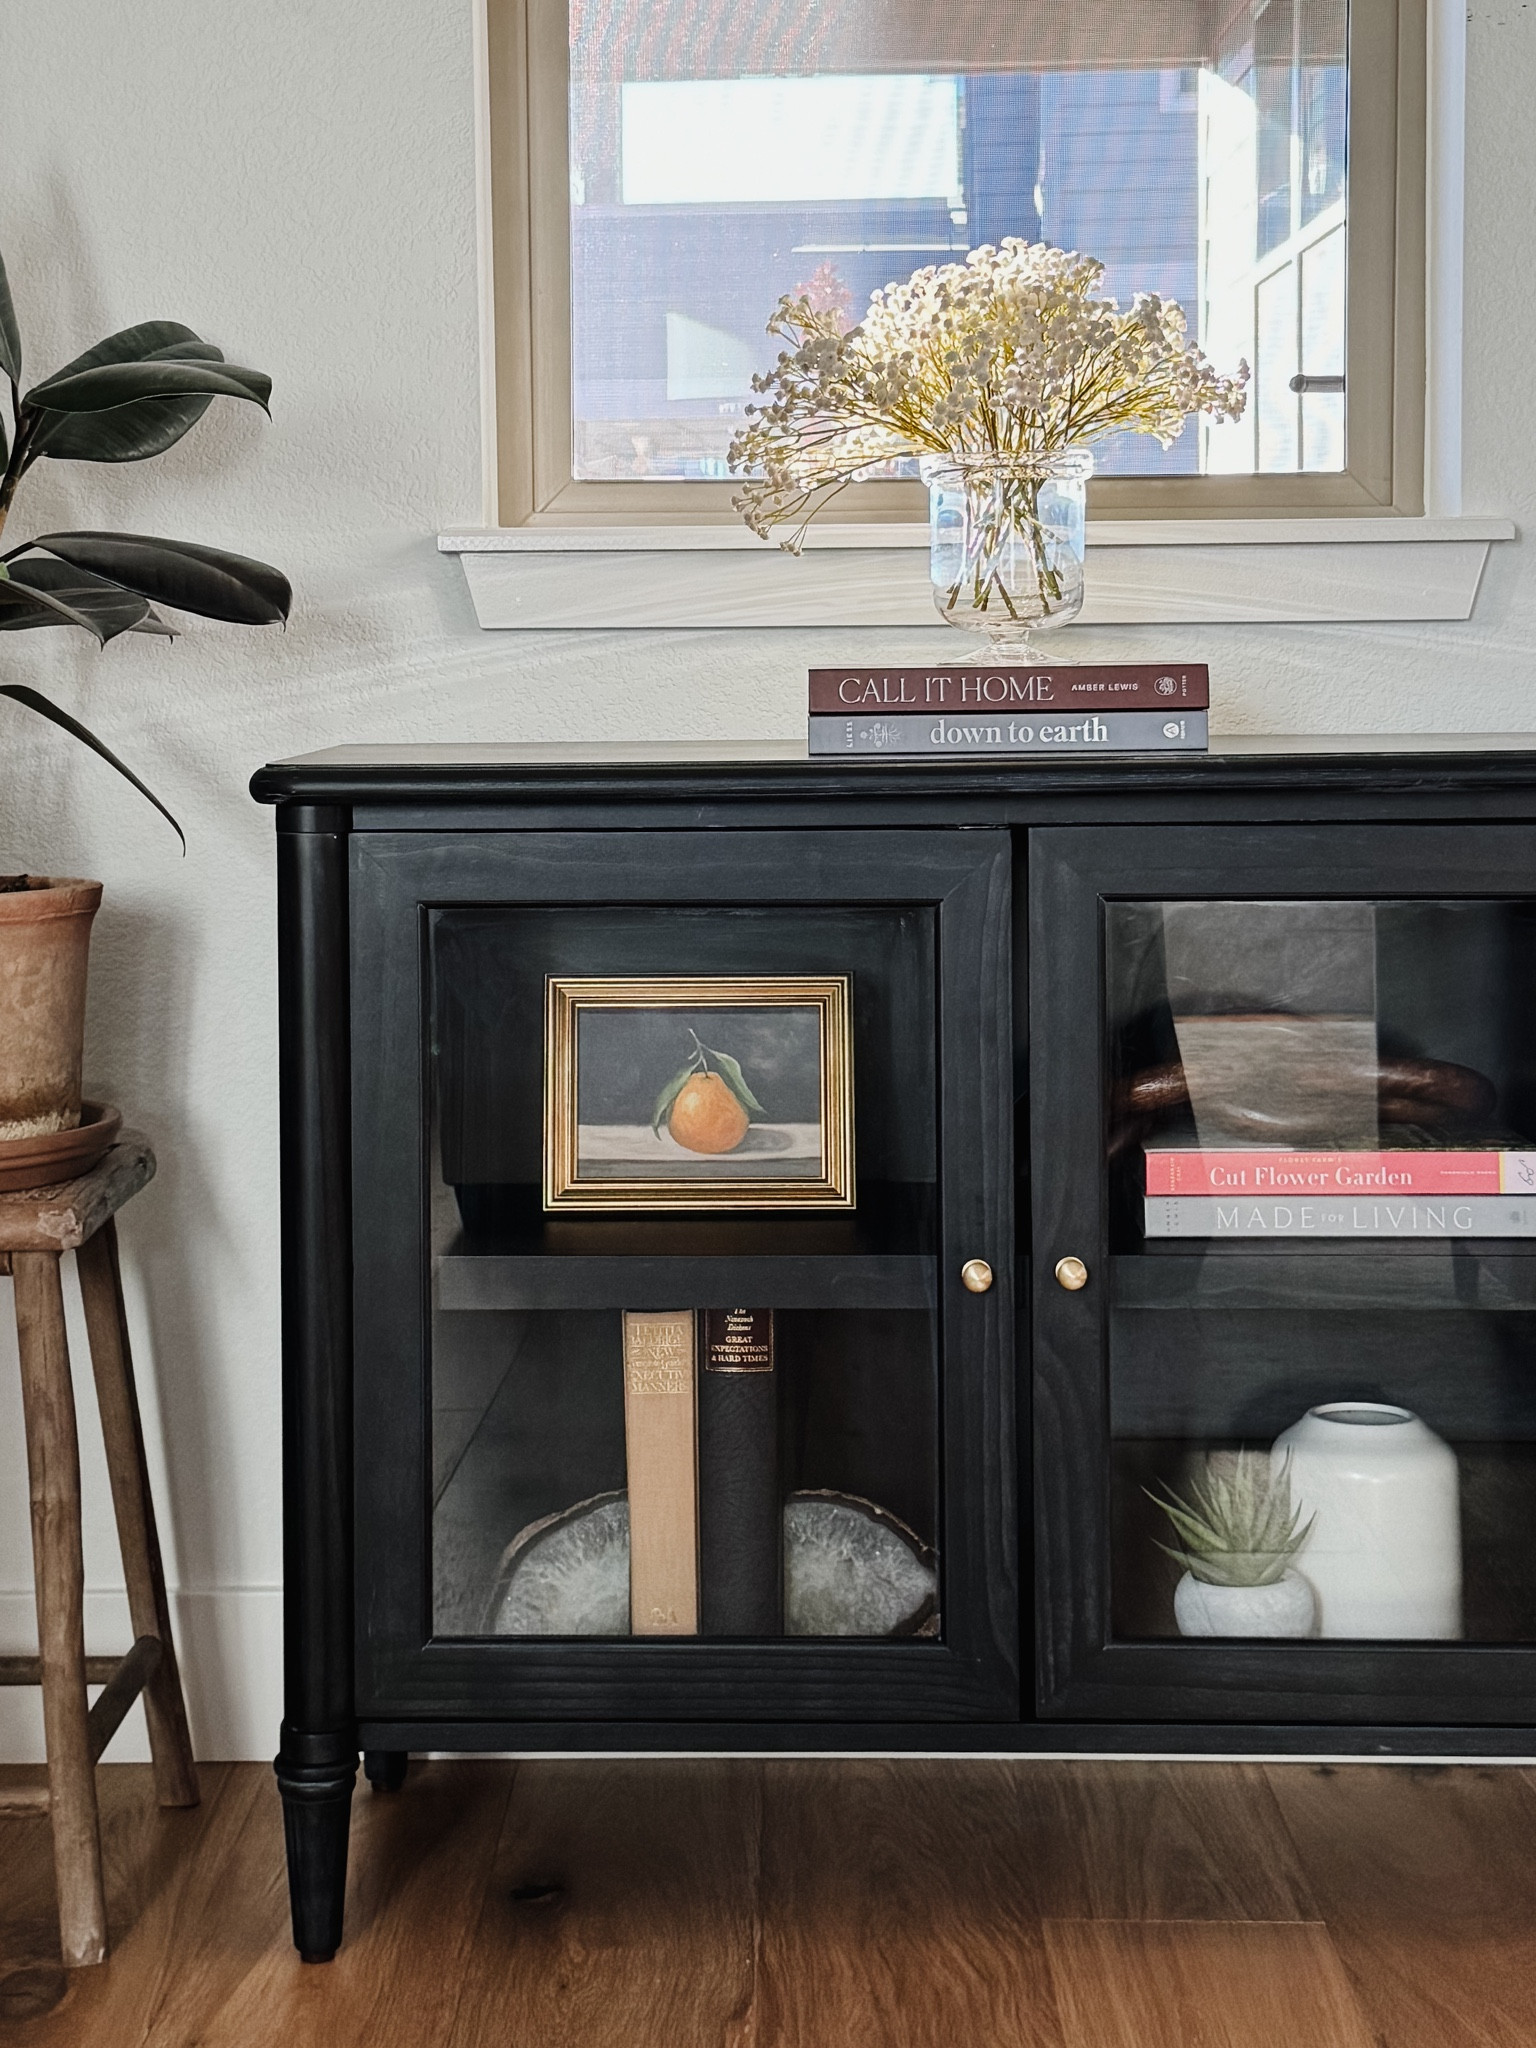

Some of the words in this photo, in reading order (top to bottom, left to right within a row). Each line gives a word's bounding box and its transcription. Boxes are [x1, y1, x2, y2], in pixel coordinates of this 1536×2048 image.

[838, 677, 917, 704] CALL
[925, 677, 952, 702] IT
[961, 676, 1055, 702] HOME
[1071, 683, 1105, 692] AMBER
[1108, 683, 1139, 691] LEWIS
[930, 719, 1002, 744] down
[1008, 721, 1034, 743] to
[1039, 717, 1109, 743] earth
[1210, 1167, 1246, 1186] Cut
[1255, 1167, 1329, 1186] Flower
[1335, 1167, 1413, 1186] Garden
[1217, 1206, 1315, 1230] MADE
[1321, 1214, 1344, 1223] FOR
[1353, 1206, 1473, 1230] LIVING
[725, 1336, 753, 1344] GREAT
[711, 1345, 768, 1353] EXPECTATIONS
[718, 1354, 742, 1363] HARD
[742, 1354, 768, 1363] TIMES
